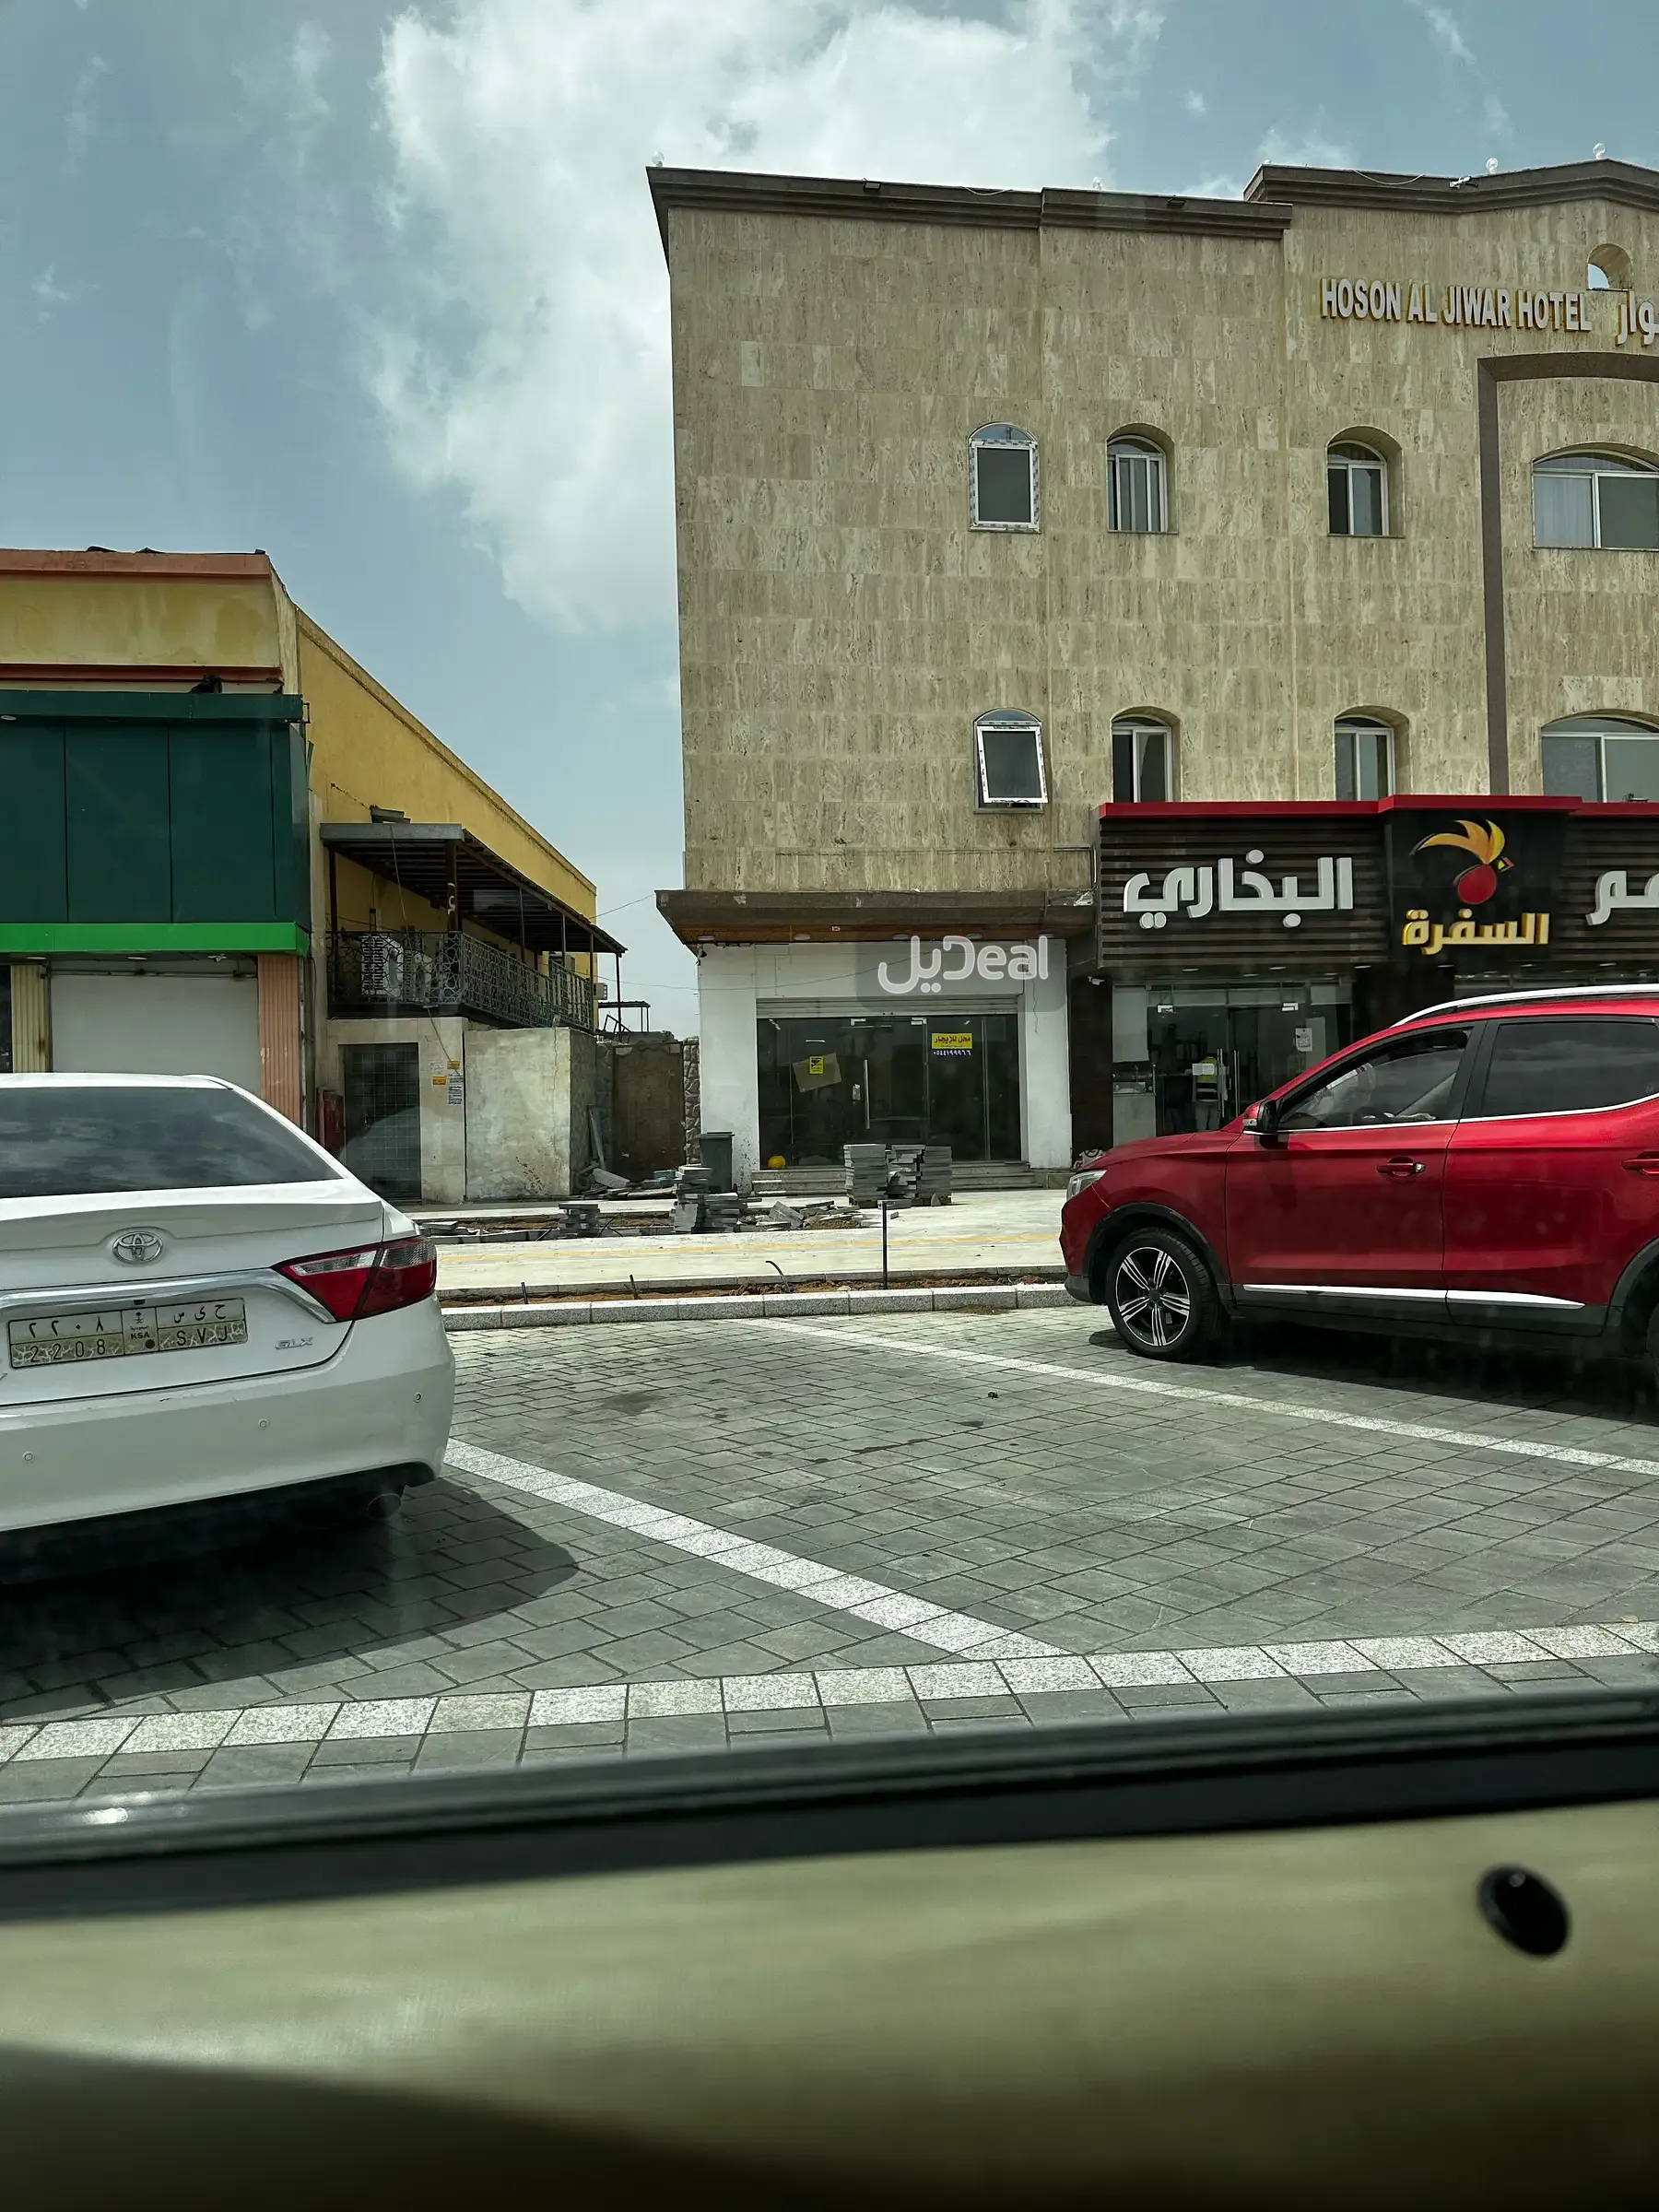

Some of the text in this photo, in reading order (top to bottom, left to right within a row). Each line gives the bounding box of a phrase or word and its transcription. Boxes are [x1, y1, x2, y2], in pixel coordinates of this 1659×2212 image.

[1321, 277, 1592, 332] HOSON AL JIWAR HOTEL
[1123, 849, 1354, 929] البخاري
[1401, 908, 1550, 955] السفرة
[958, 1035, 971, 1043] محل
[130, 1332, 150, 1340] KSA
[276, 1336, 313, 1349] GLX
